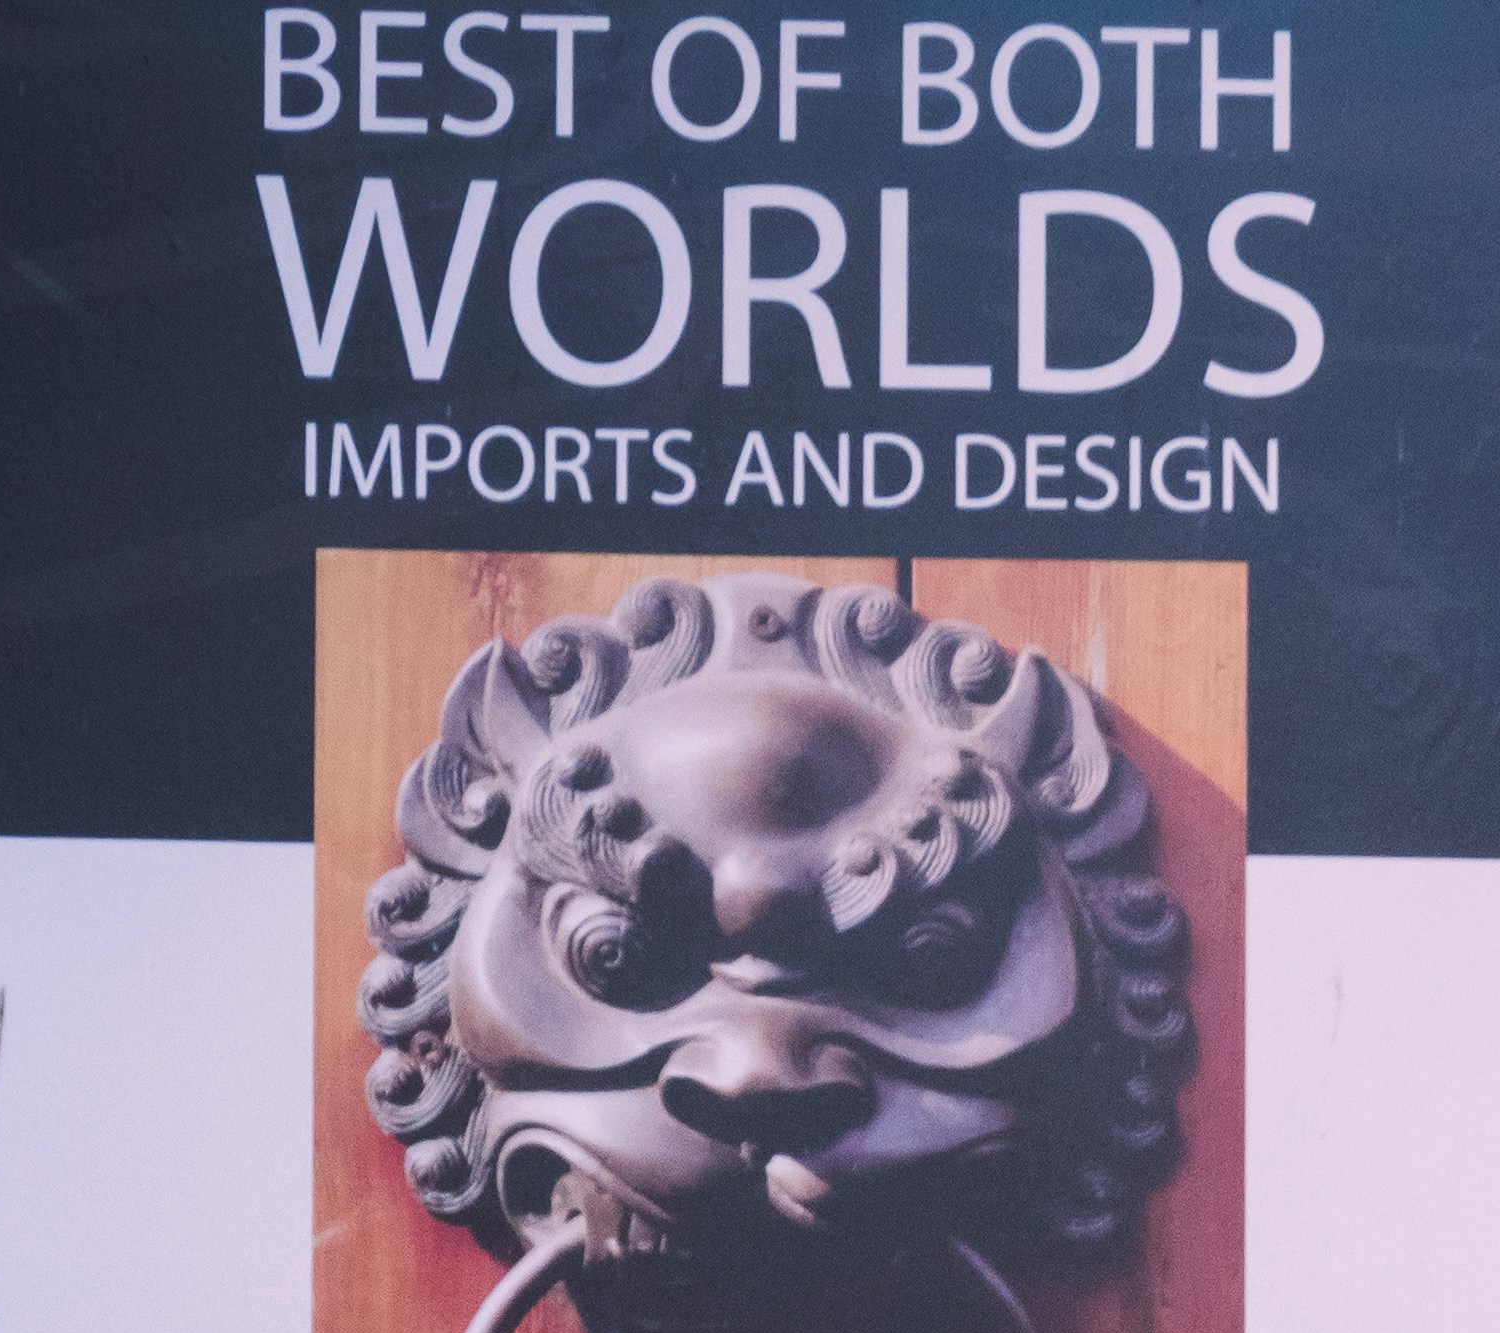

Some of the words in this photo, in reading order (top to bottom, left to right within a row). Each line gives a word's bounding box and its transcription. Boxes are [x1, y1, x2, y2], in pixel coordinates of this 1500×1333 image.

[264, 8, 608, 134] BEST
[650, 17, 843, 142] OF
[900, 24, 1292, 151] BOTH
[258, 175, 1325, 399] WORLDS
[303, 422, 694, 508] IMPORTS
[726, 430, 926, 509] AND
[953, 435, 1280, 516] DESIGN
